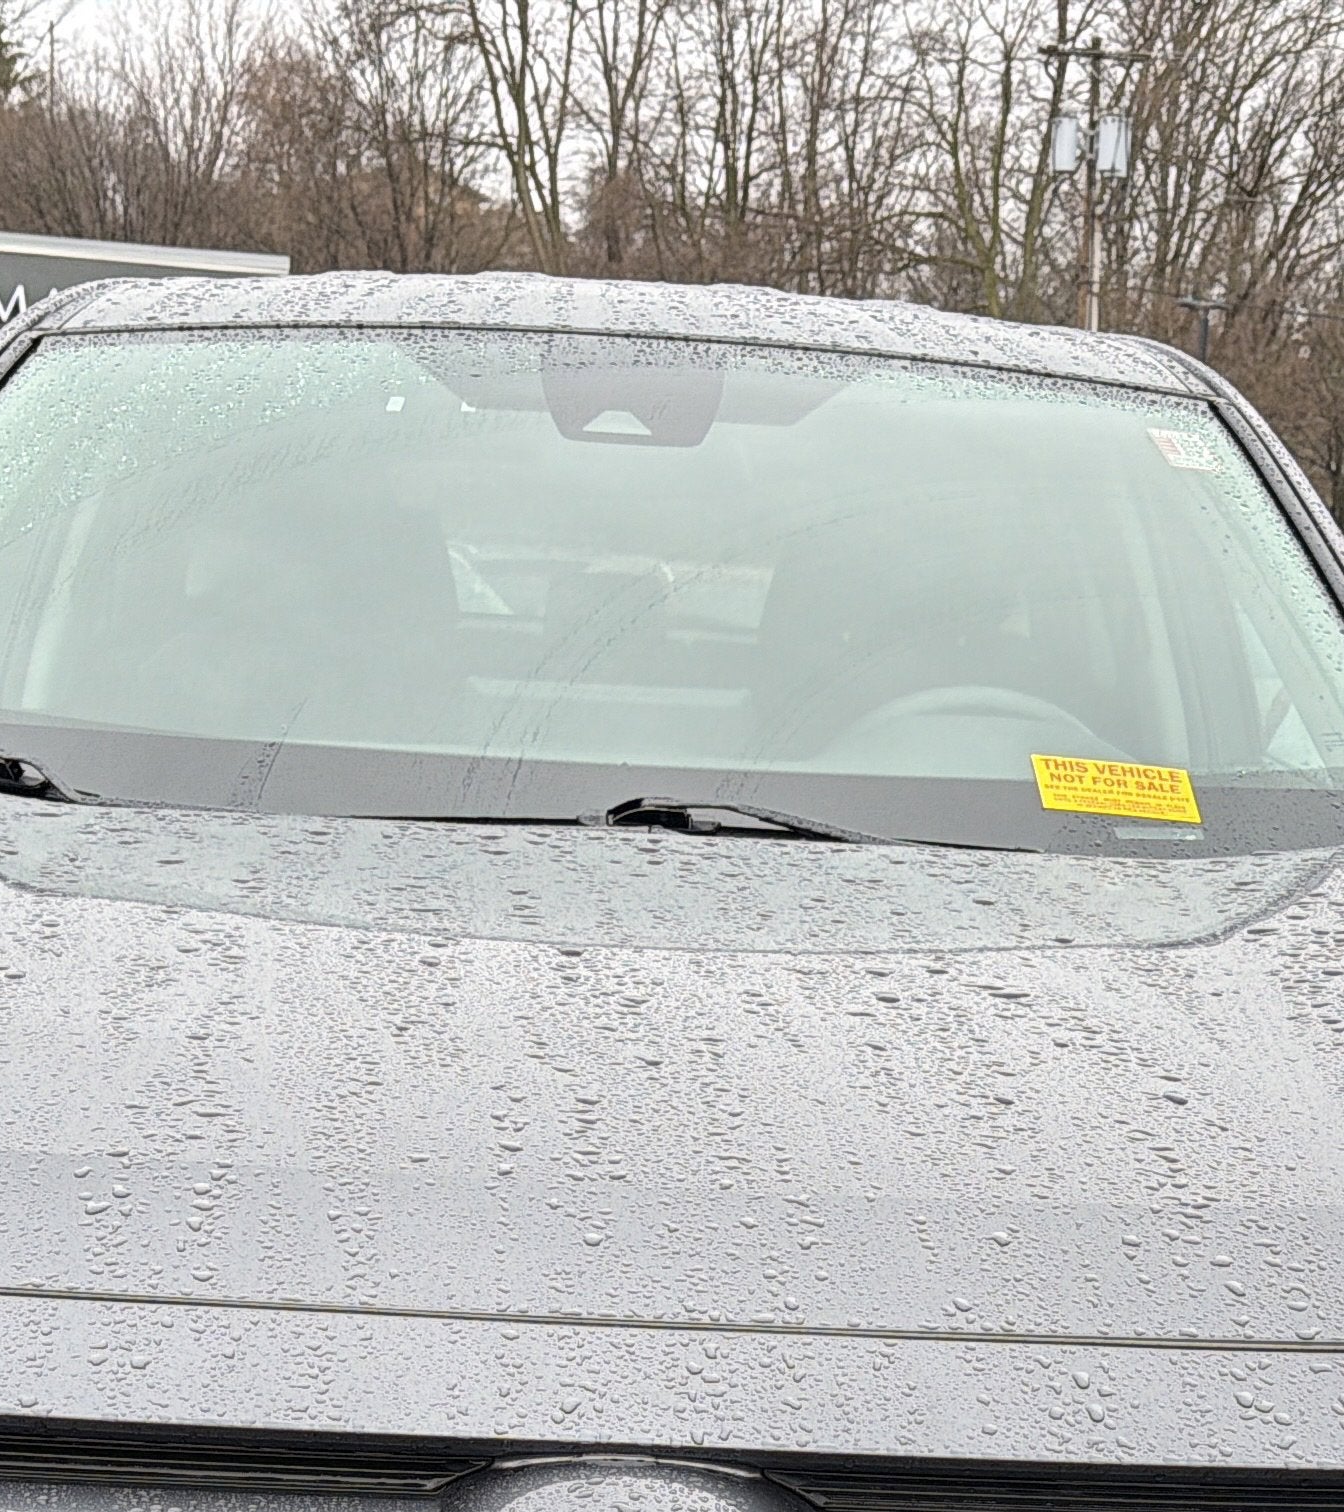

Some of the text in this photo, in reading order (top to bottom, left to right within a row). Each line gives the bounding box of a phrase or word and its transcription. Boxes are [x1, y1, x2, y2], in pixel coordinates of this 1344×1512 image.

[1040, 758, 1184, 784] THIS VEHICLE
[1049, 772, 1182, 795] NOT FOR SALE
